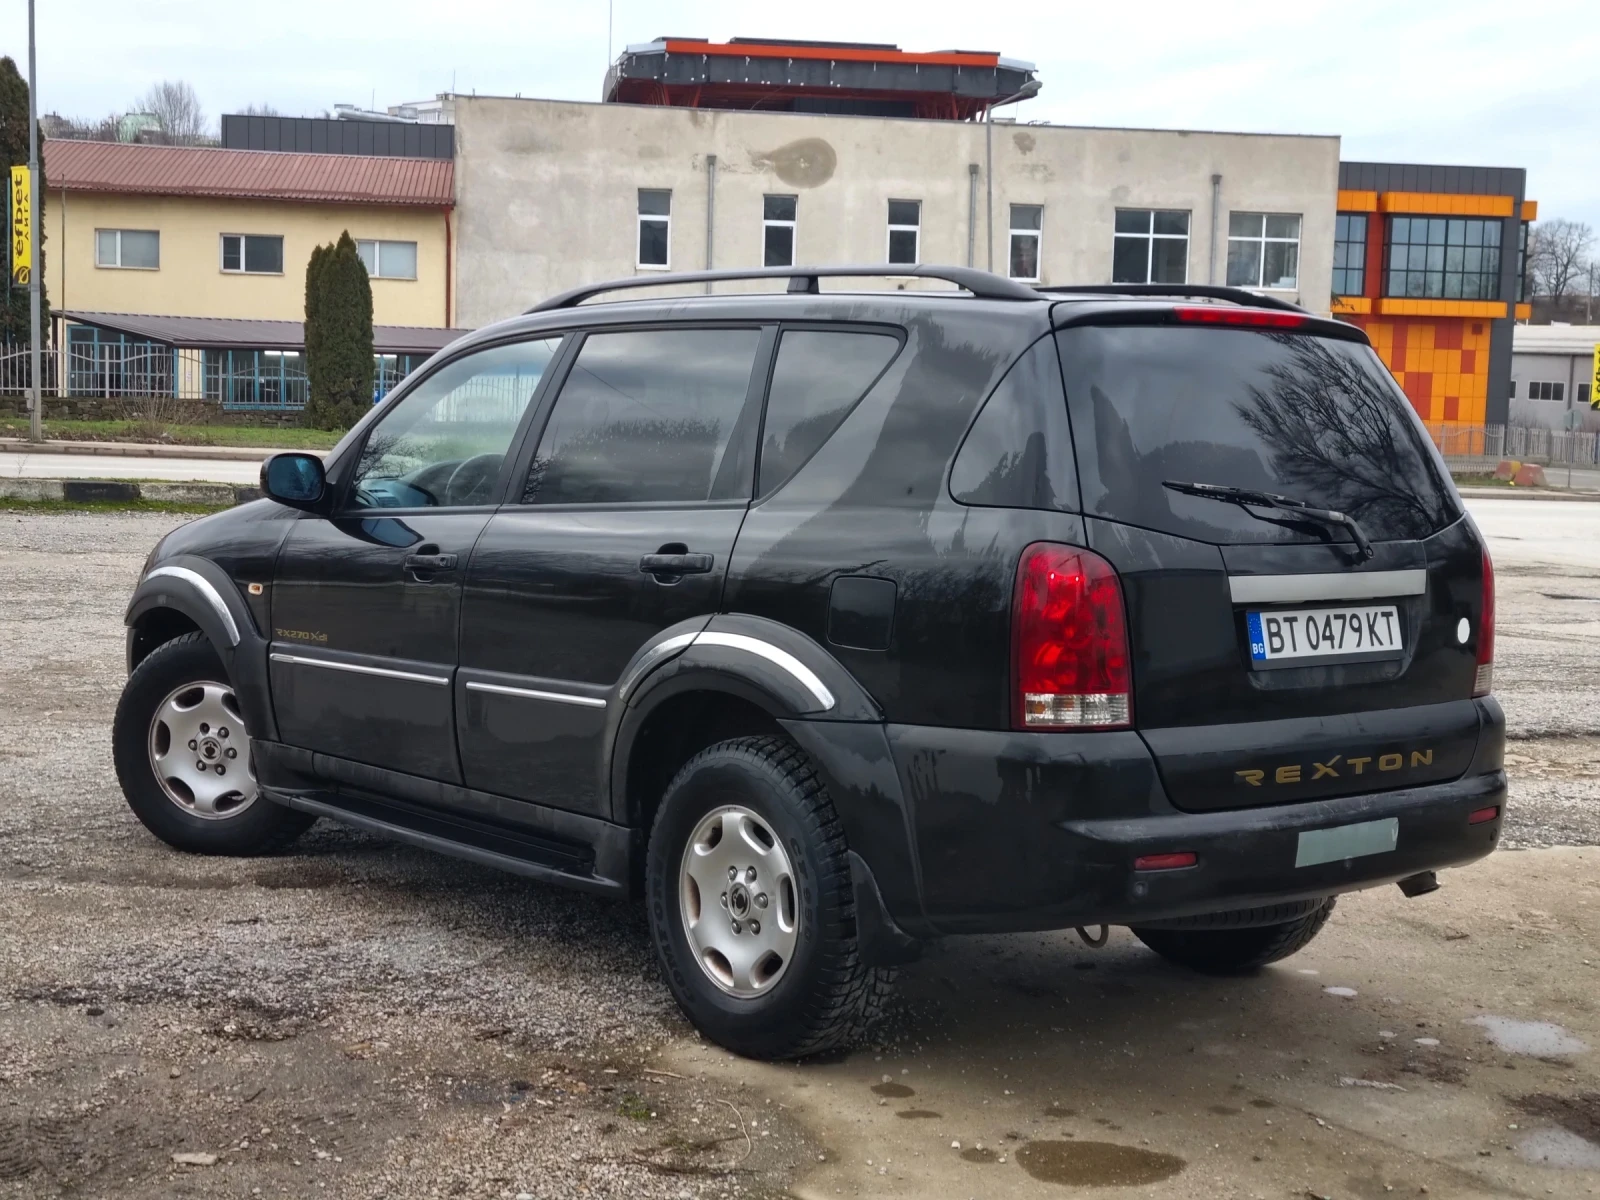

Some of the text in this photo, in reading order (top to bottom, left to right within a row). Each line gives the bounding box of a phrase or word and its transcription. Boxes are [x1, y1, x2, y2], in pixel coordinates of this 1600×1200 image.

[14, 173, 24, 257] efbet
[1252, 643, 1265, 654] BG
[1265, 611, 1394, 653] BT 0479 KT
[1235, 750, 1433, 786] REXTON
